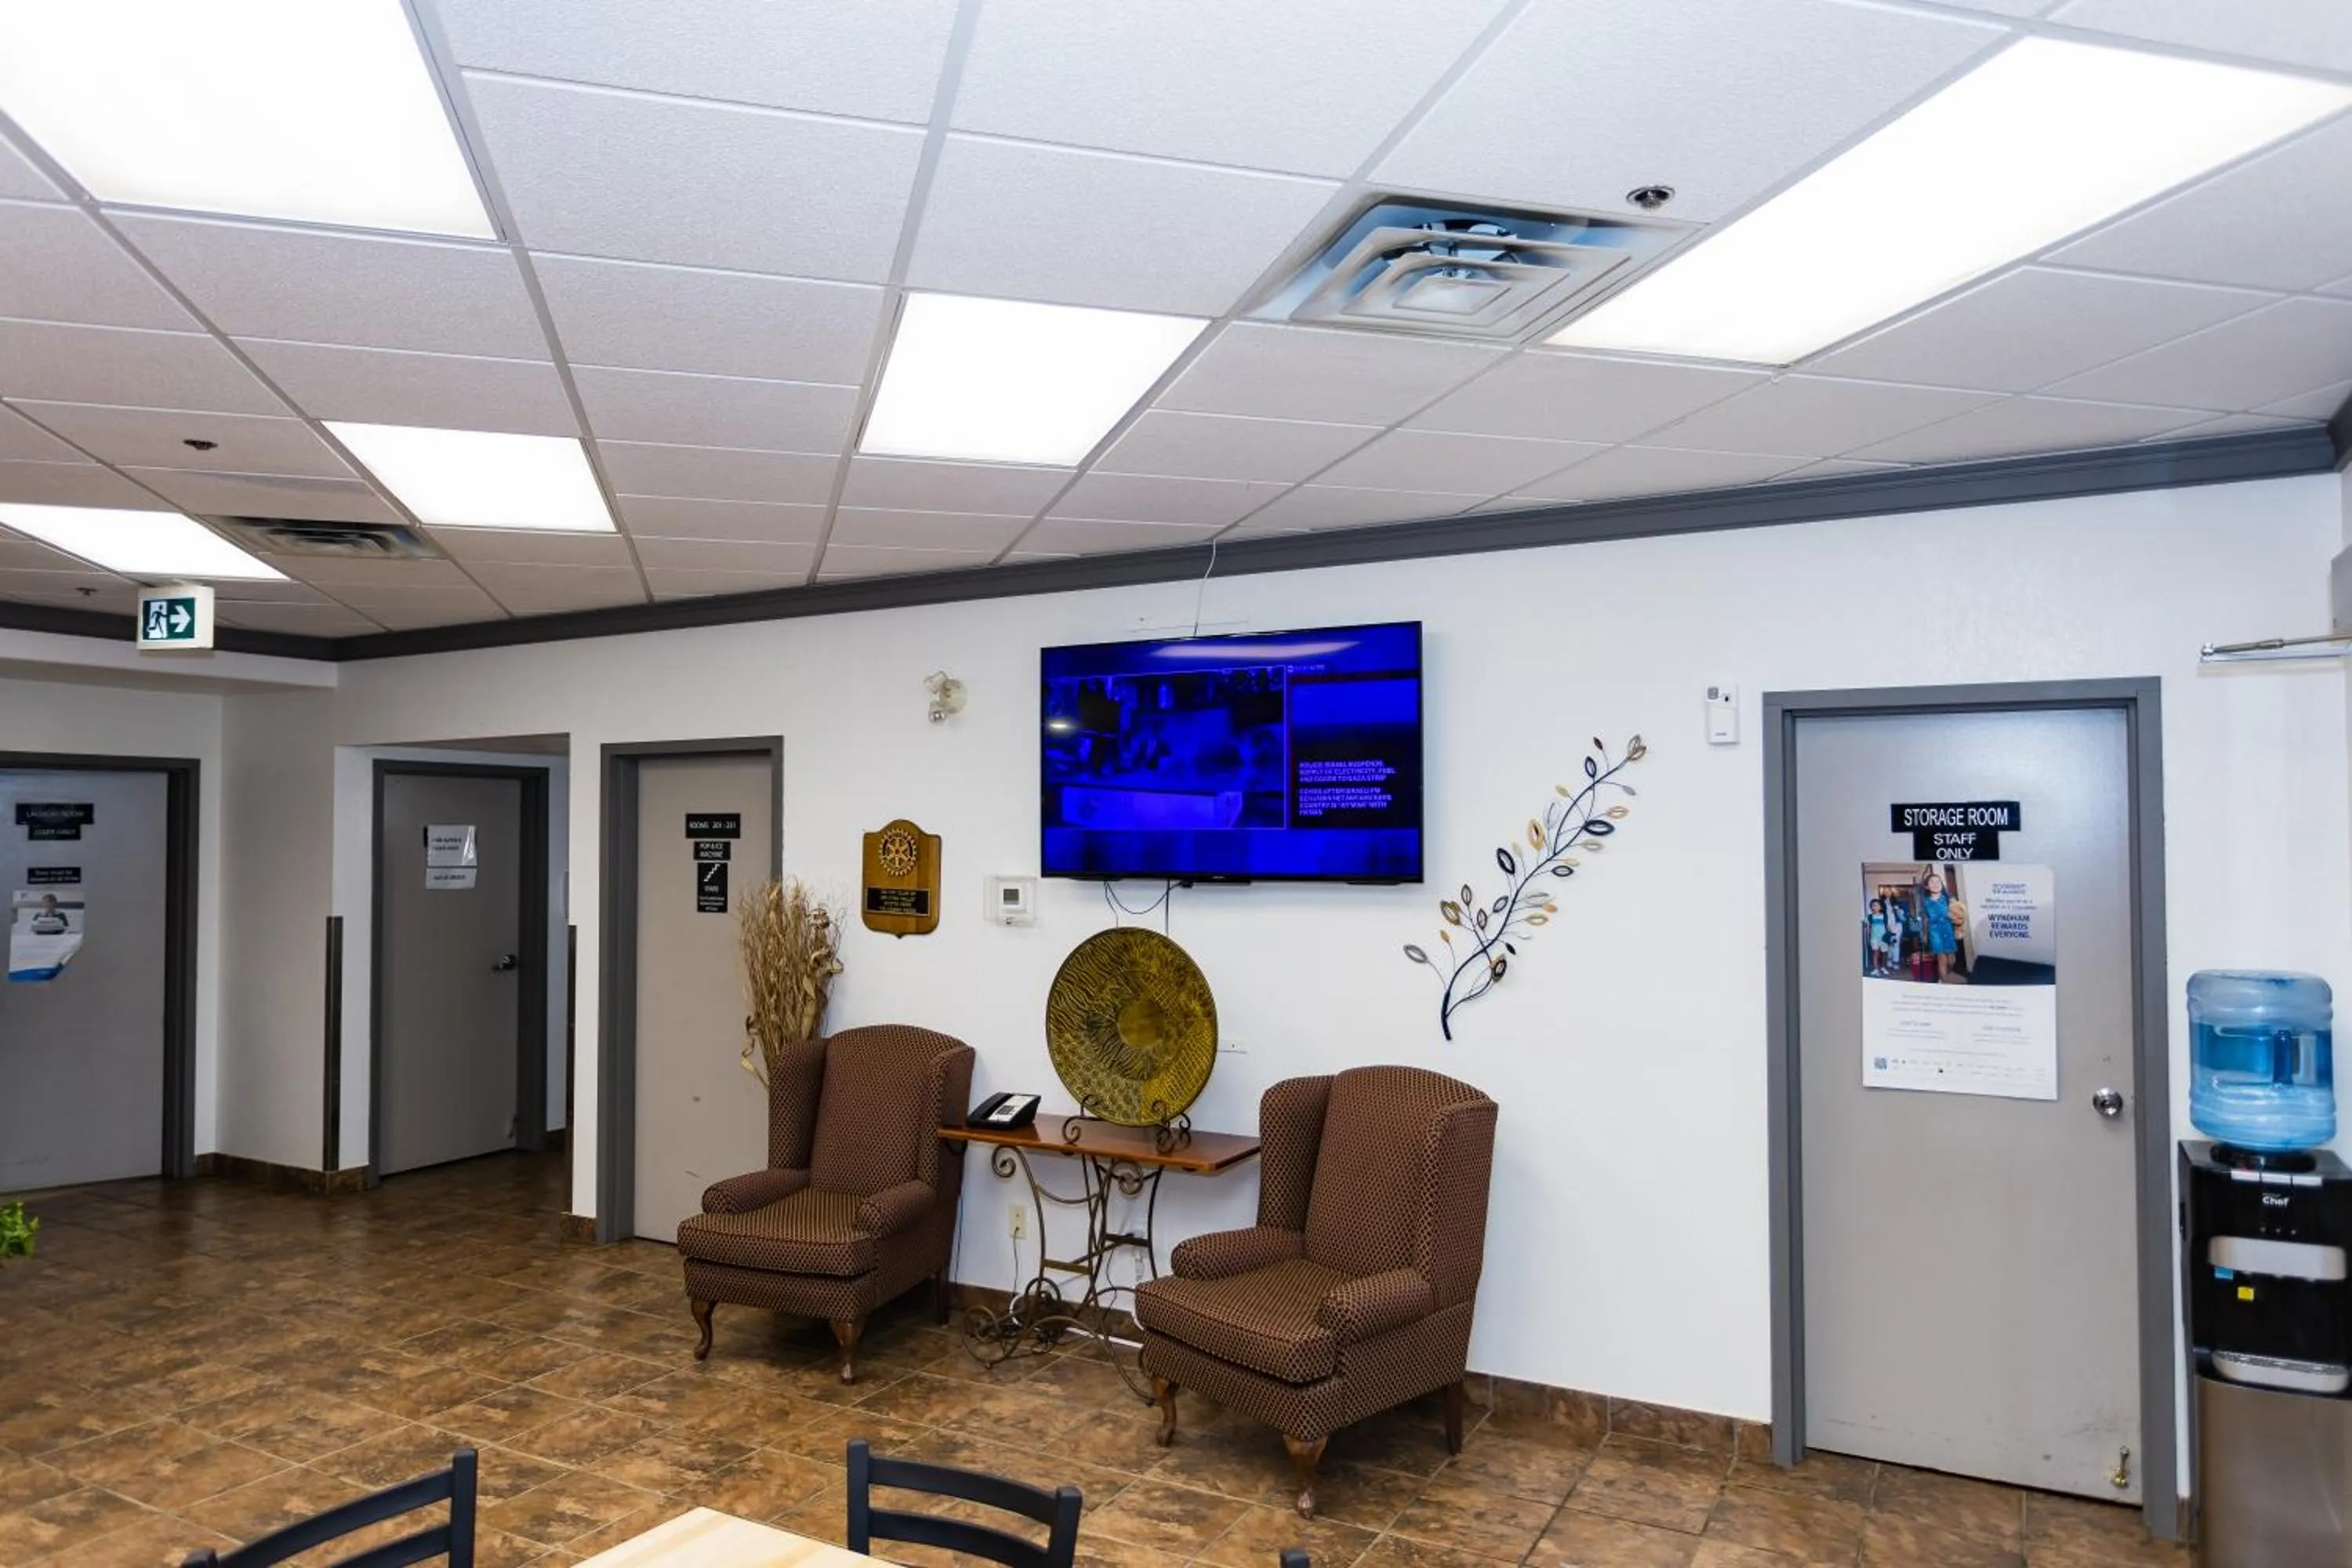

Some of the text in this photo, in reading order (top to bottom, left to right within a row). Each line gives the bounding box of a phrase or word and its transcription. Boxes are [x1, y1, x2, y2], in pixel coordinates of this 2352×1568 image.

[1904, 808, 2008, 826] STORAGE ROOM
[1933, 833, 1976, 845] STAFF
[1936, 848, 1974, 860] ONLY
[2263, 1196, 2289, 1207] Chef
